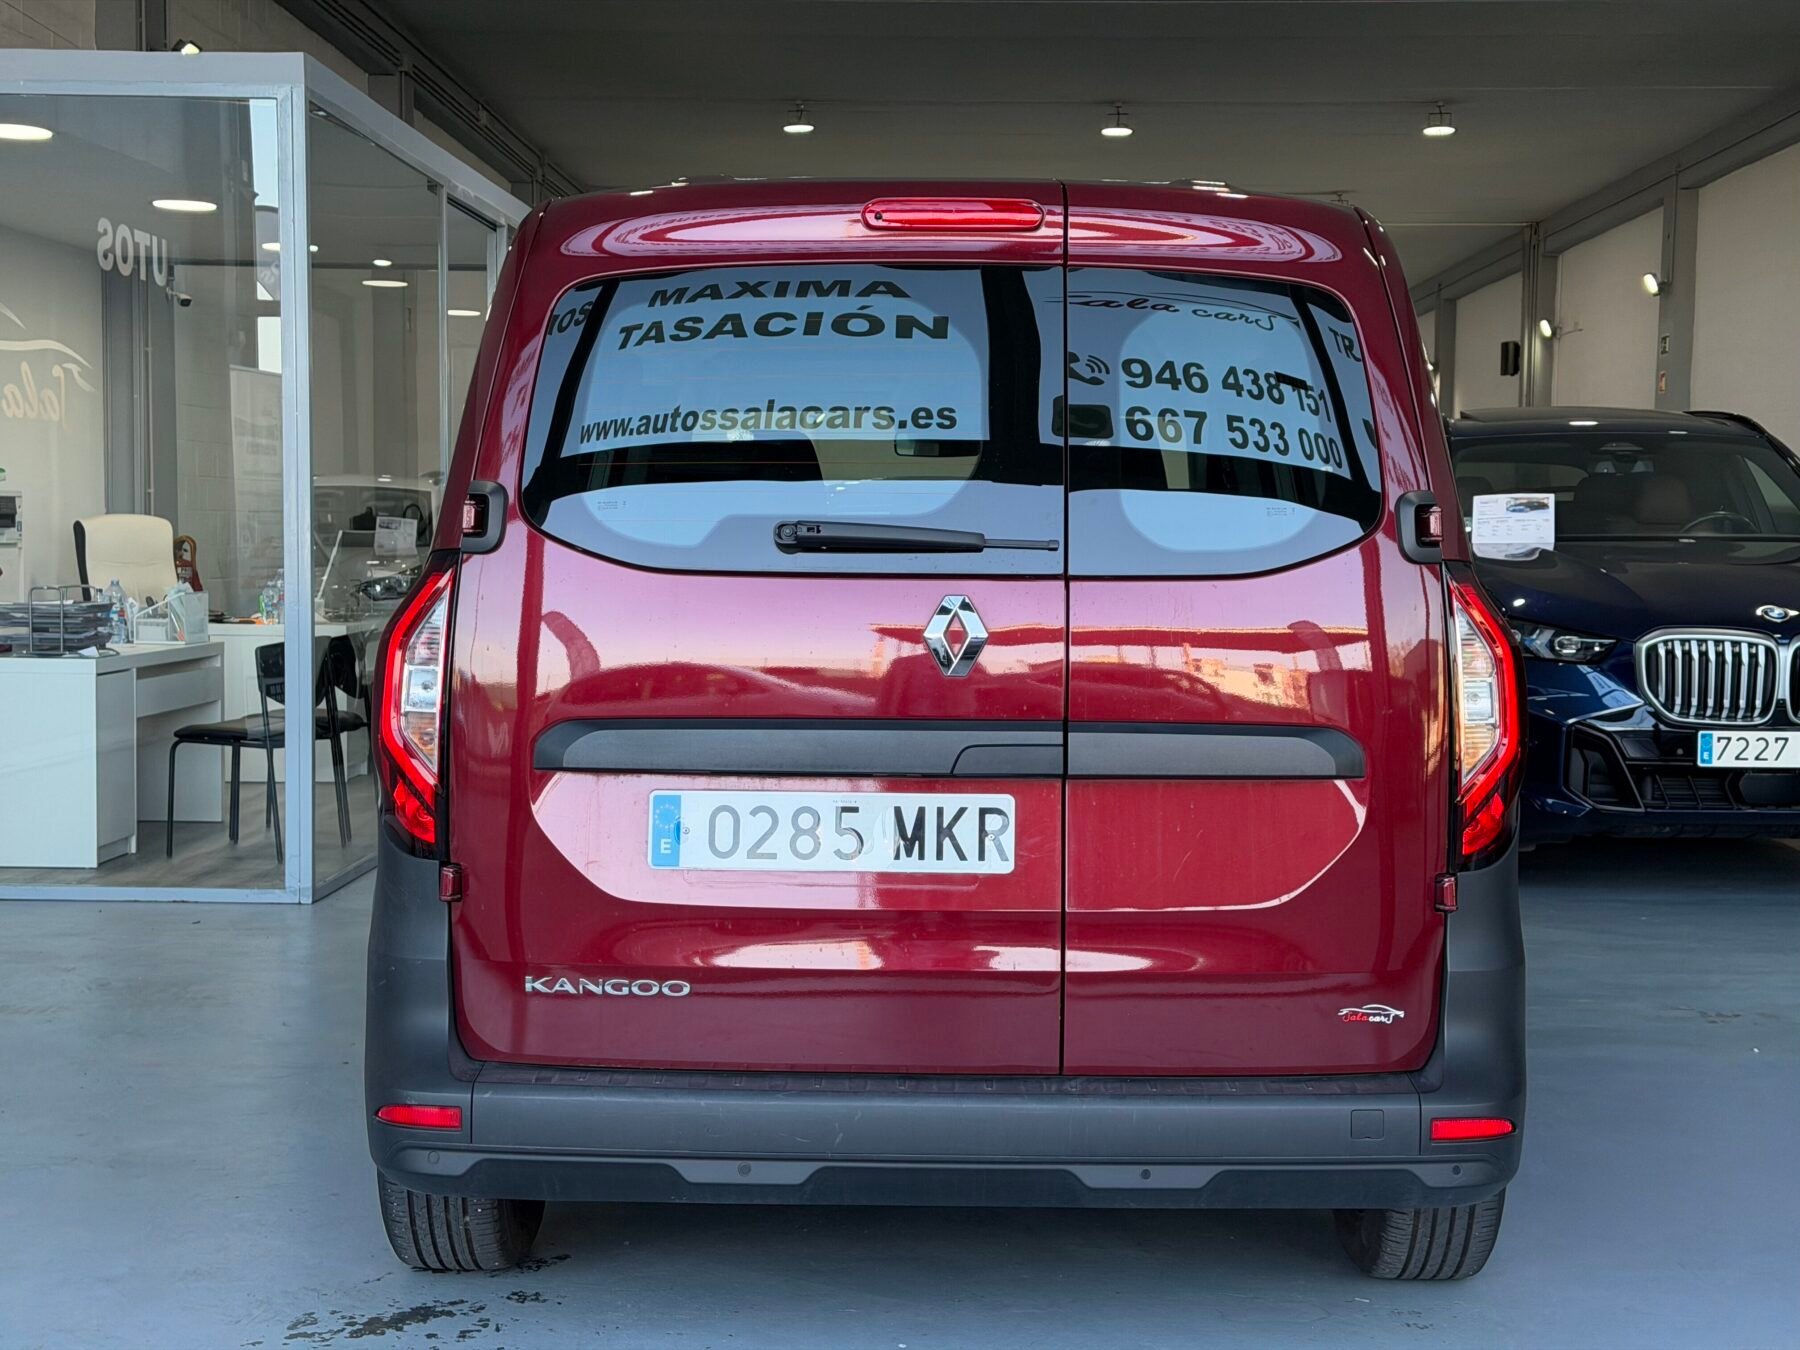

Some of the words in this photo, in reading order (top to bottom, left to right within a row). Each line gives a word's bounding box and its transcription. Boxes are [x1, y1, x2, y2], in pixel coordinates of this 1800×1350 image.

[647, 279, 912, 308] MAXIMA
[617, 305, 950, 351] TASACIÓN
[1120, 357, 1209, 394] 946
[1221, 365, 1285, 405] 438
[580, 398, 958, 445] www.autossalacars.es
[1125, 405, 1208, 445] 667
[1226, 414, 1290, 457] 533
[1298, 427, 1343, 469] 000
[1716, 736, 1790, 762] 7227
[659, 838, 672, 854] E
[707, 804, 865, 861] 0285
[893, 805, 1011, 862] MKR
[524, 975, 691, 997] KANGOO
